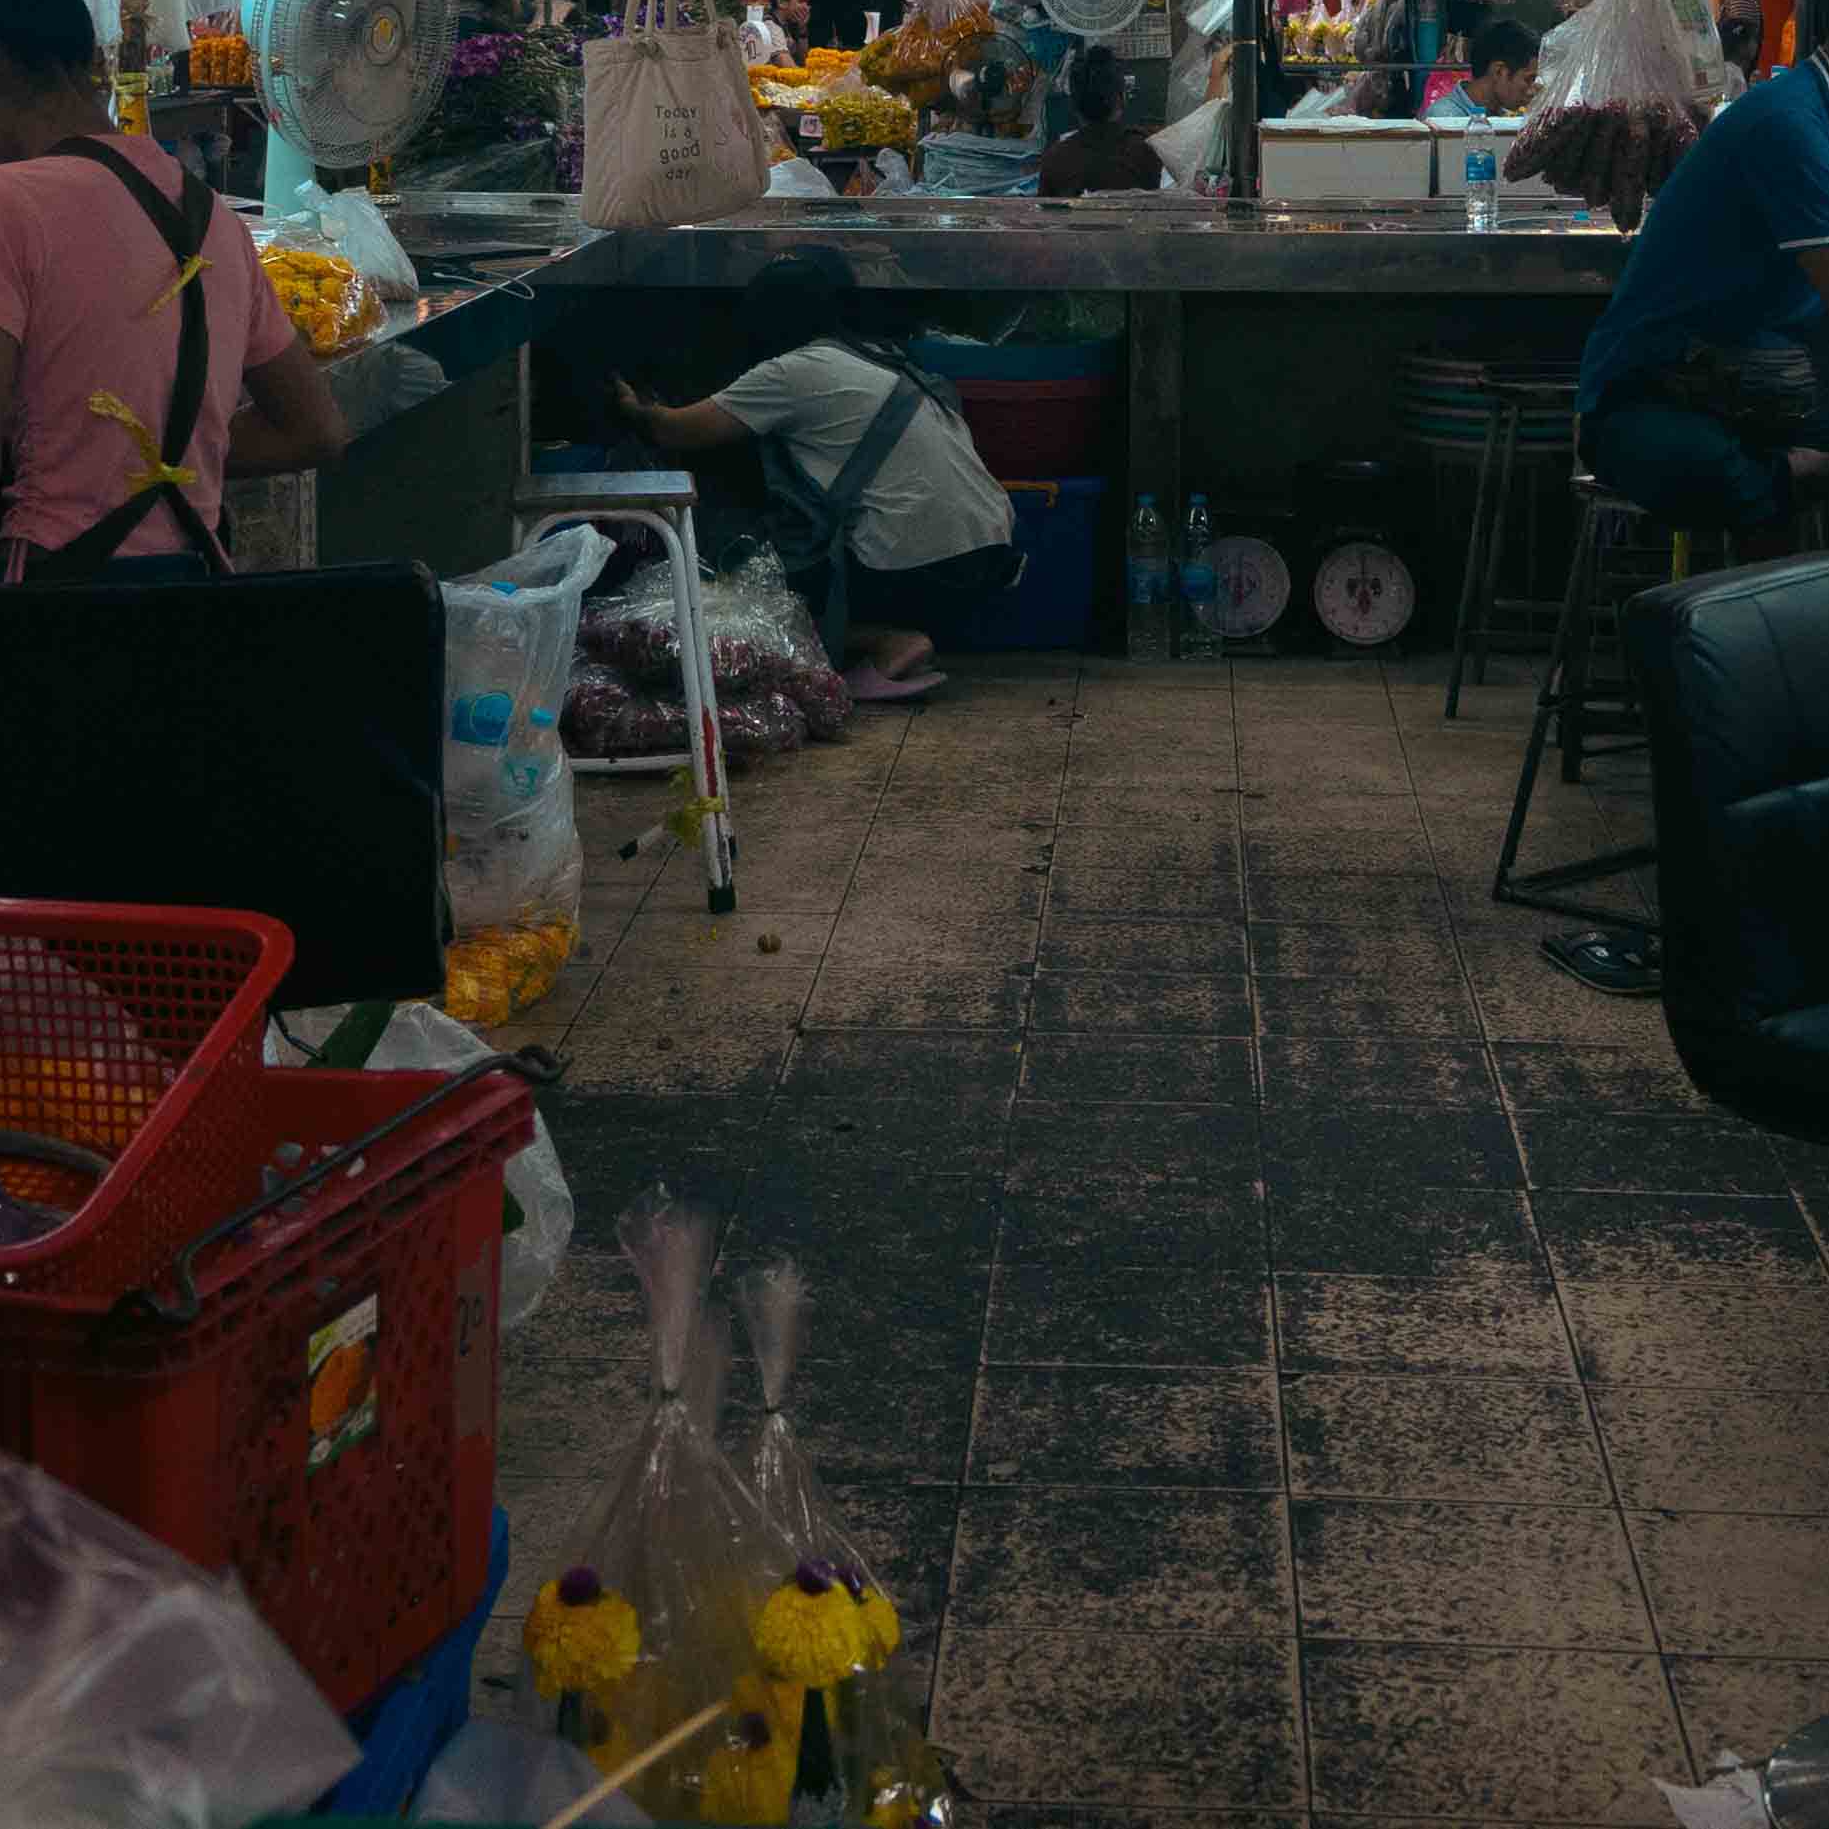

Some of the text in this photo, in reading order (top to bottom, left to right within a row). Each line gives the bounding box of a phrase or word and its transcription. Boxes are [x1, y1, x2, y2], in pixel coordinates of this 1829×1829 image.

[654, 105, 697, 119] Today
[663, 126, 677, 139] is
[659, 140, 701, 165] good
[665, 165, 693, 181] day
